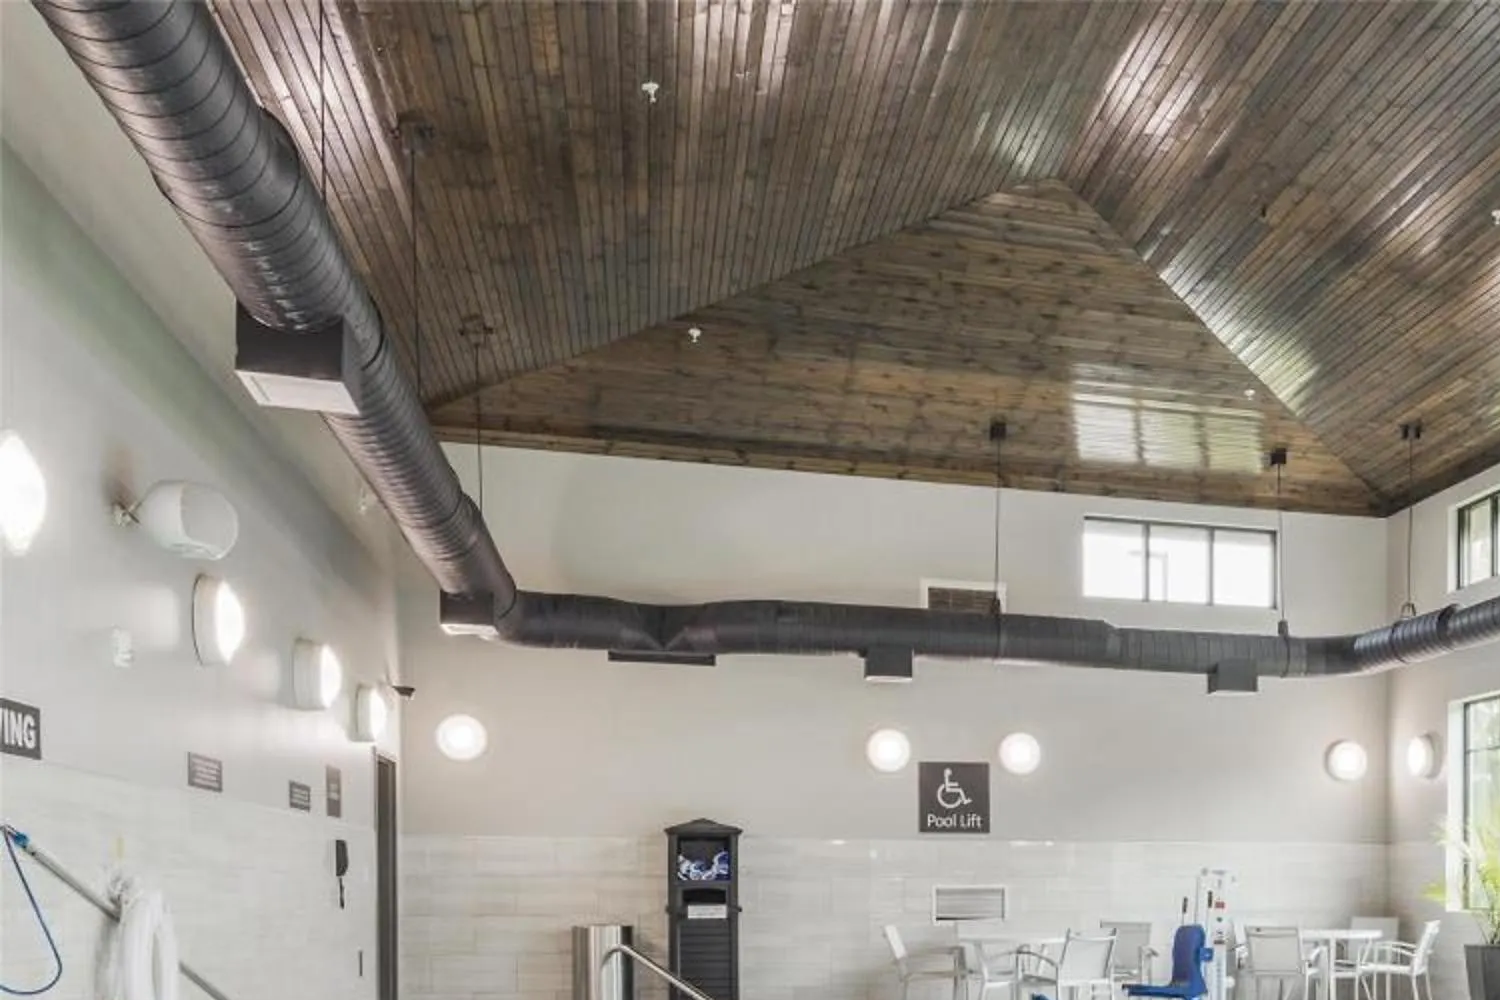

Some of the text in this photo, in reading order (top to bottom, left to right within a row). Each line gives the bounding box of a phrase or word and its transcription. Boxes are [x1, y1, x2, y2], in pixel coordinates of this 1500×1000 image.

[0, 707, 36, 749] ING
[927, 813, 982, 829] Pool Lift
